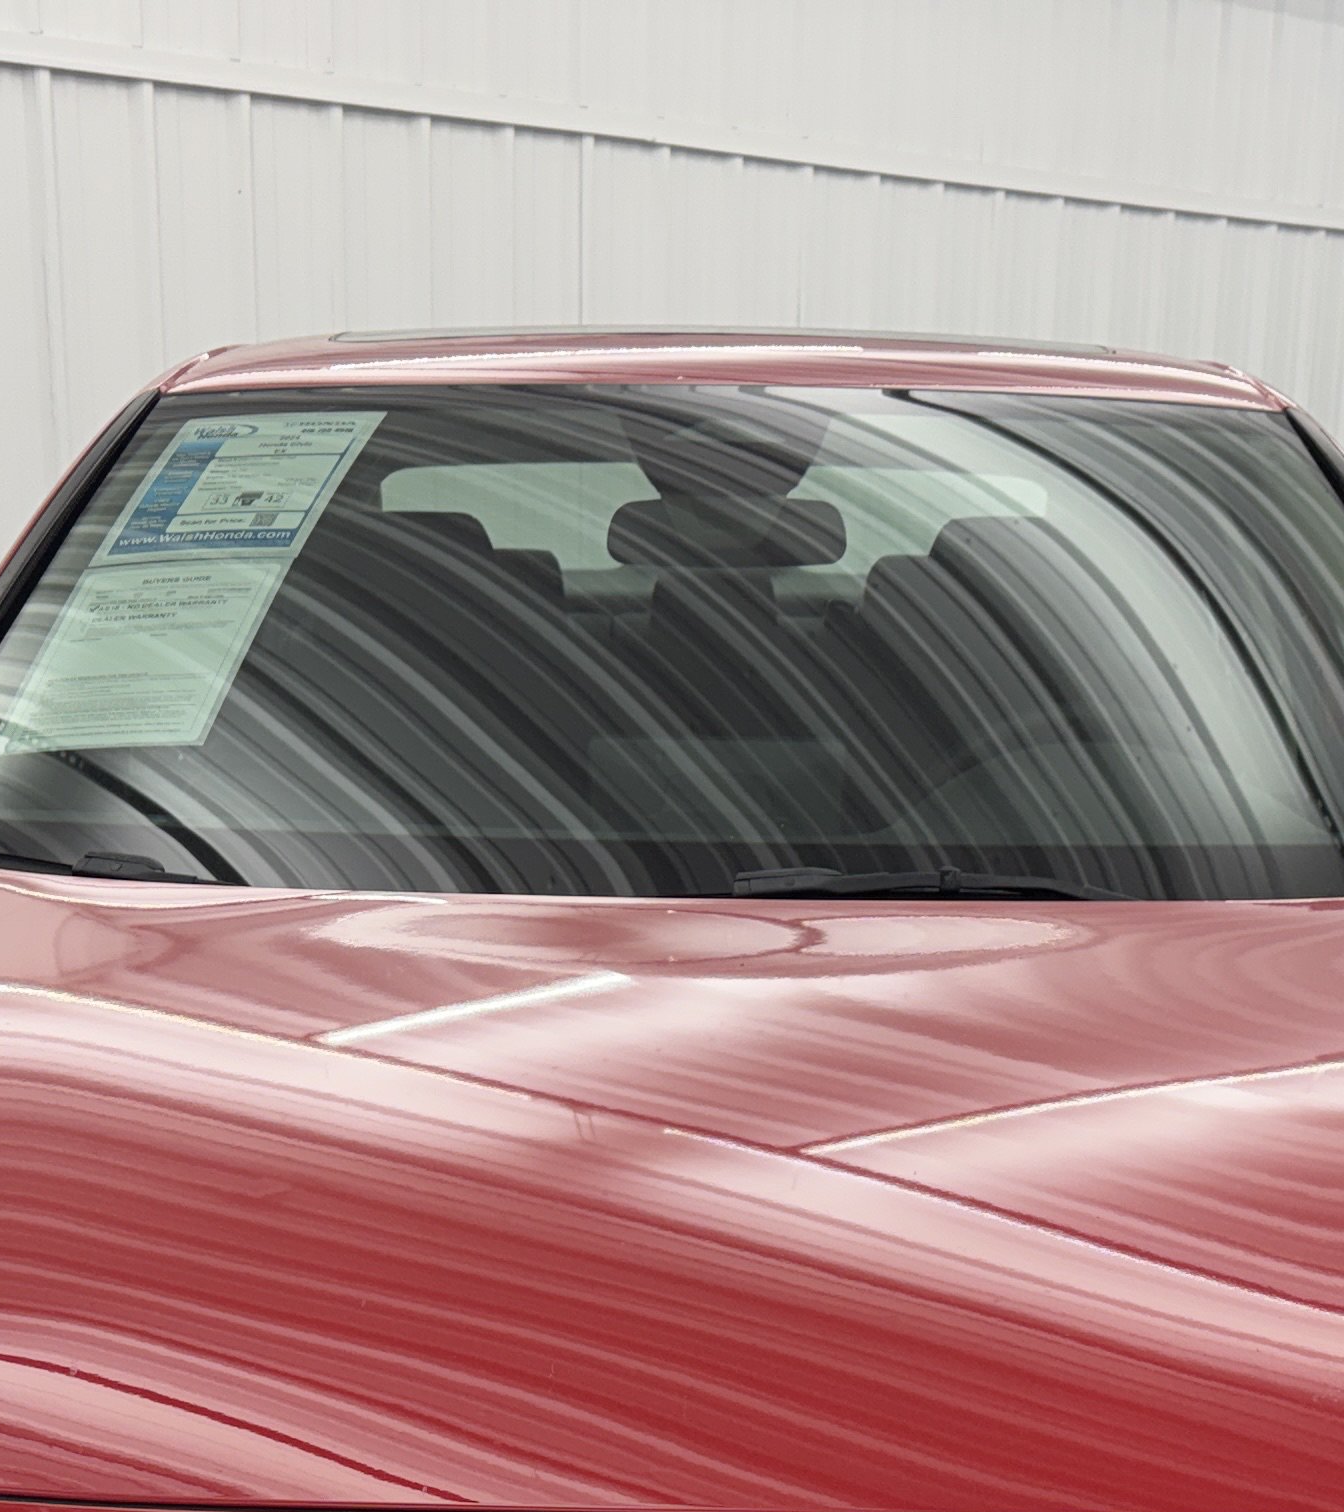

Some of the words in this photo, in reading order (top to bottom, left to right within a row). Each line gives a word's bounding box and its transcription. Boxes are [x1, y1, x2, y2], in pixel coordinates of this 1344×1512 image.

[263, 494, 285, 504] 42
[179, 518, 202, 526] Scan
[118, 530, 292, 547] www.WalshHonda.com
